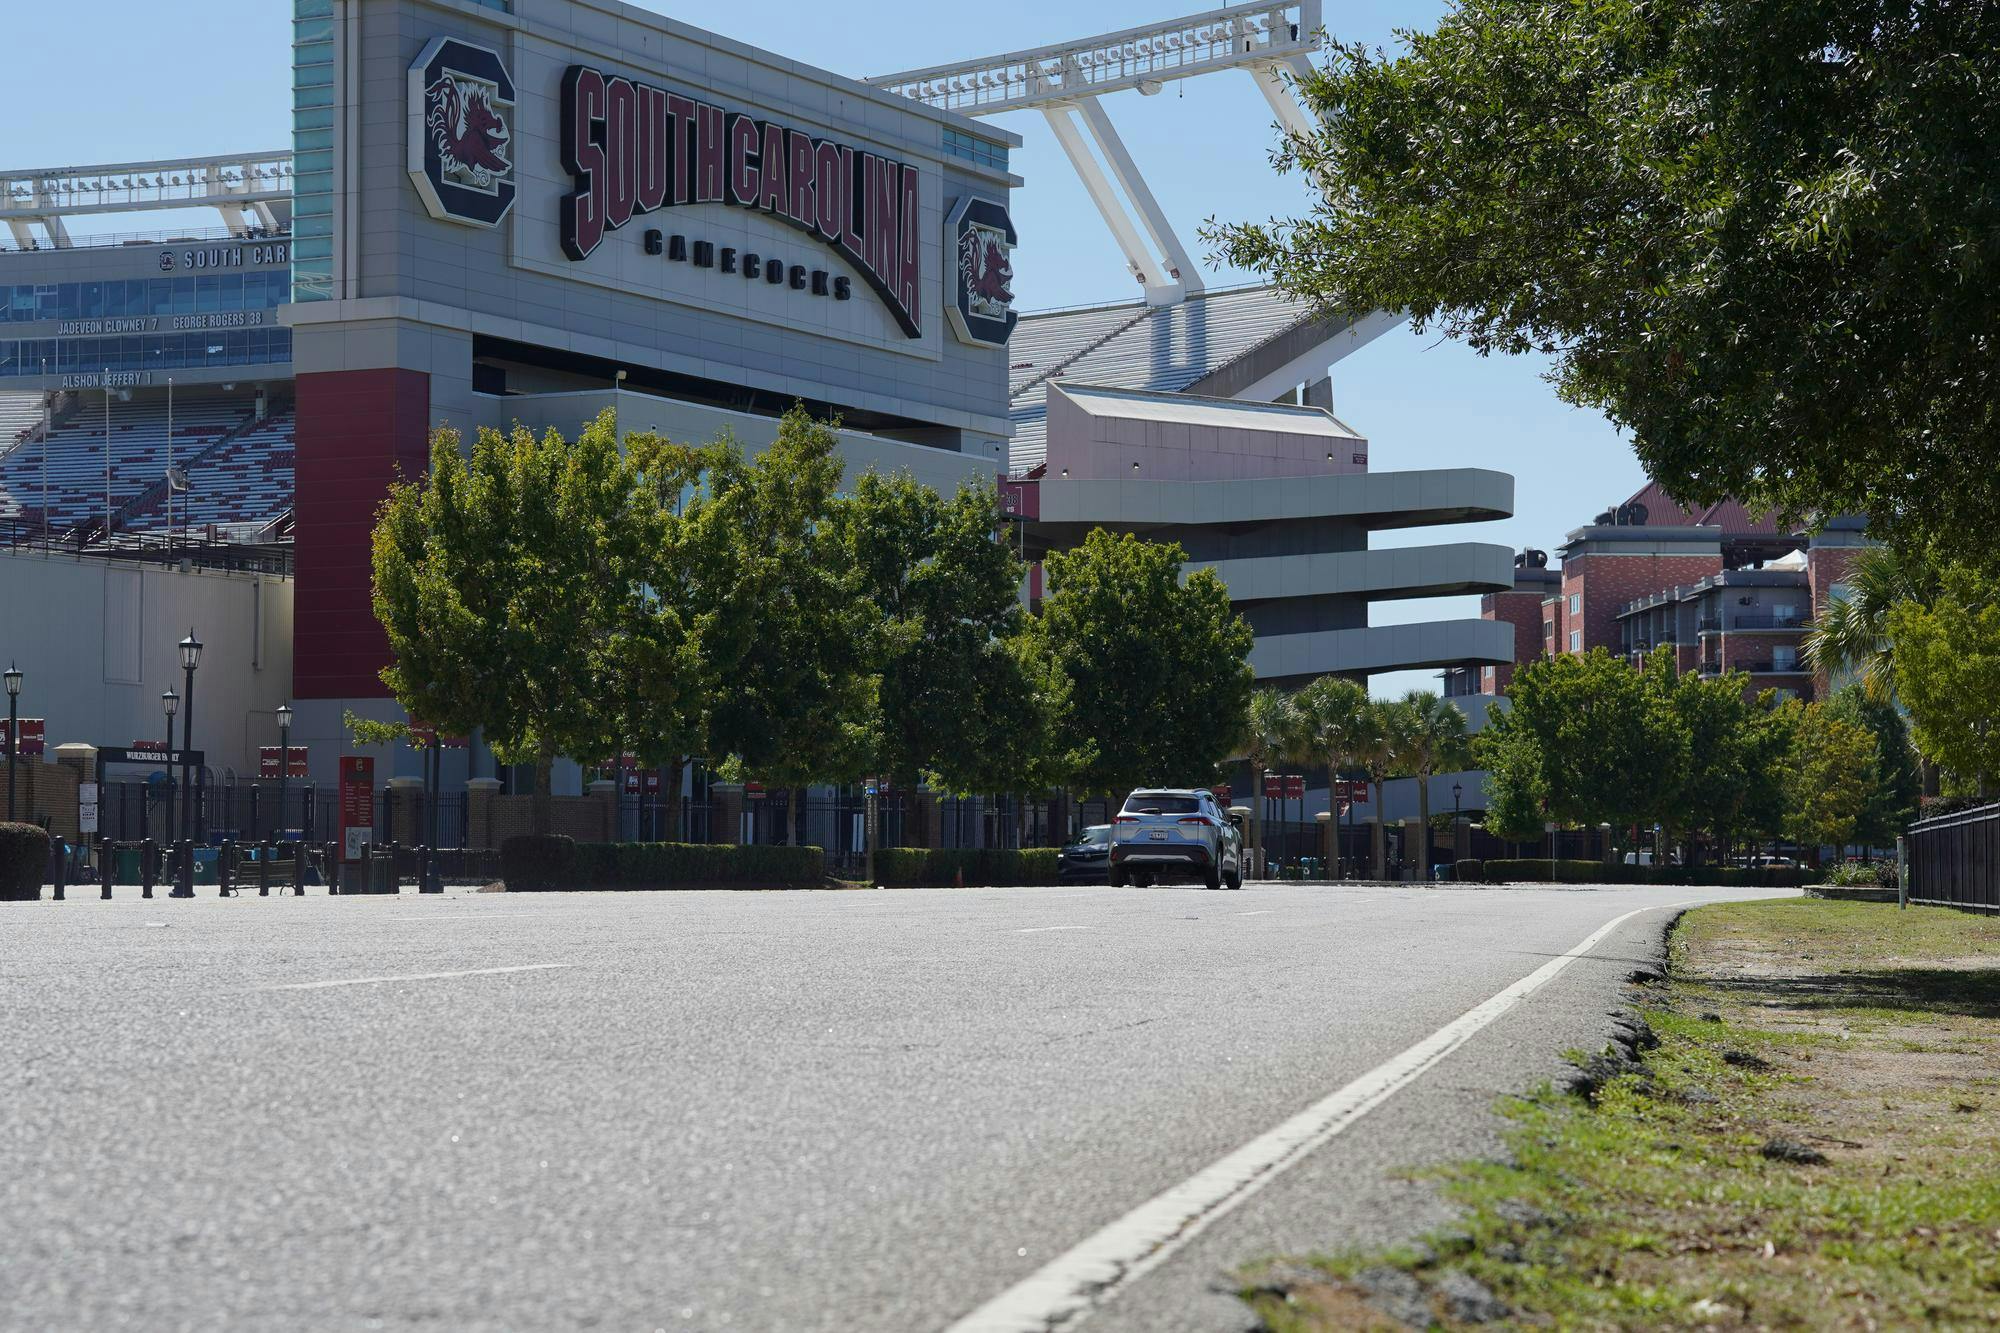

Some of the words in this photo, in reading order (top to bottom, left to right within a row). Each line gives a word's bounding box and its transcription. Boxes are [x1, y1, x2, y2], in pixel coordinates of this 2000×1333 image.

[561, 65, 725, 261] SOUTH
[727, 113, 921, 338] CAROLINA
[184, 247, 242, 269] SOUTH
[253, 244, 292, 265] CAR
[644, 228, 851, 301] GAMECOCKS
[58, 320, 102, 335] JADEVEON
[105, 318, 146, 333] CLOWNEY
[152, 317, 158, 331] 7
[173, 314, 207, 329] GEORGE
[209, 312, 245, 327] ROGERS
[250, 311, 262, 325] 38
[62, 373, 99, 388] ALSHON
[101, 371, 143, 387] JEFFERY
